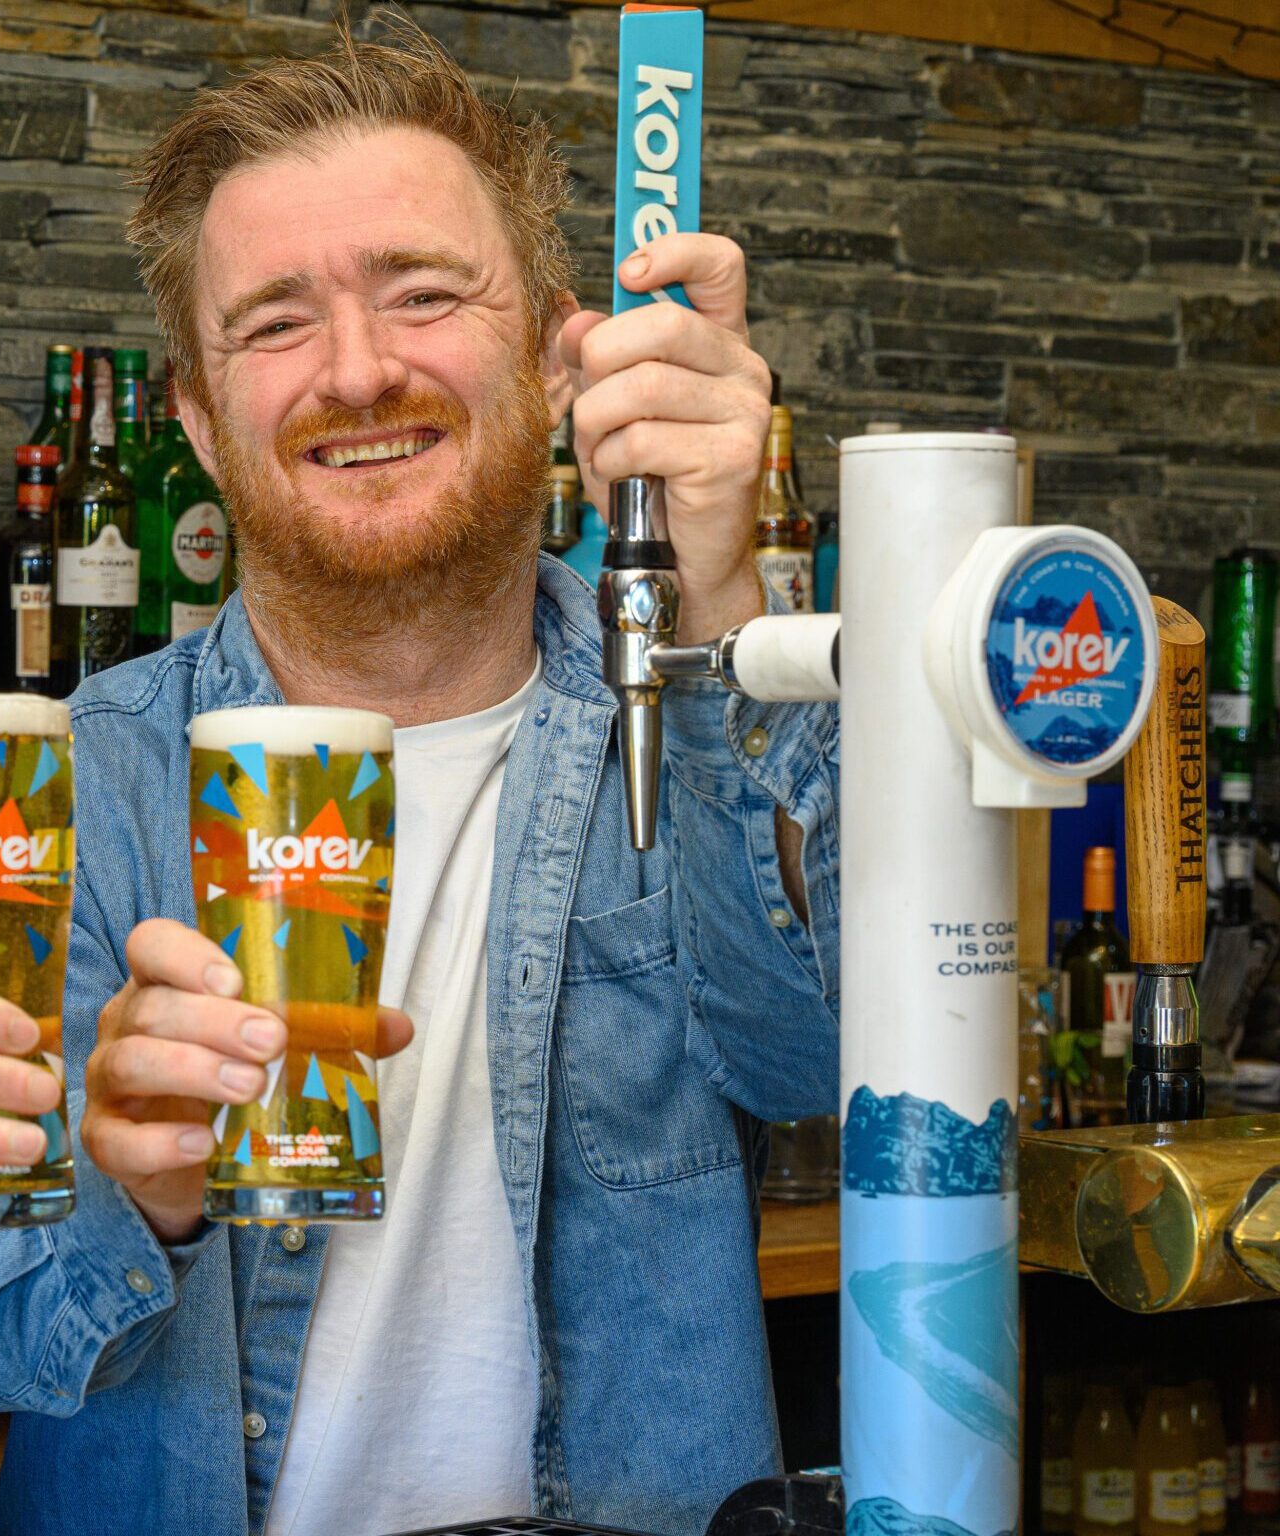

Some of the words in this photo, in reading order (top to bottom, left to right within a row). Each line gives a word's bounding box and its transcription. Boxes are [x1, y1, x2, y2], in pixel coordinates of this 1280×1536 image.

[633, 64, 693, 303] kore
[1014, 617, 1130, 672] korev
[1050, 675, 1062, 684] IN
[1034, 689, 1102, 709] LAGER
[1176, 665, 1203, 894] THATCHERS
[247, 828, 374, 870] korev
[248, 873, 285, 883] BORN
[289, 873, 304, 881] IN
[930, 923, 977, 937] THE
[958, 942, 979, 956] IS
[984, 941, 1015, 956] OUR
[264, 1134, 294, 1145] THE
[295, 1134, 343, 1145] COAST
[280, 1145, 295, 1156] IS
[296, 1145, 329, 1156] OUR
[268, 1156, 340, 1168] COMPASS
